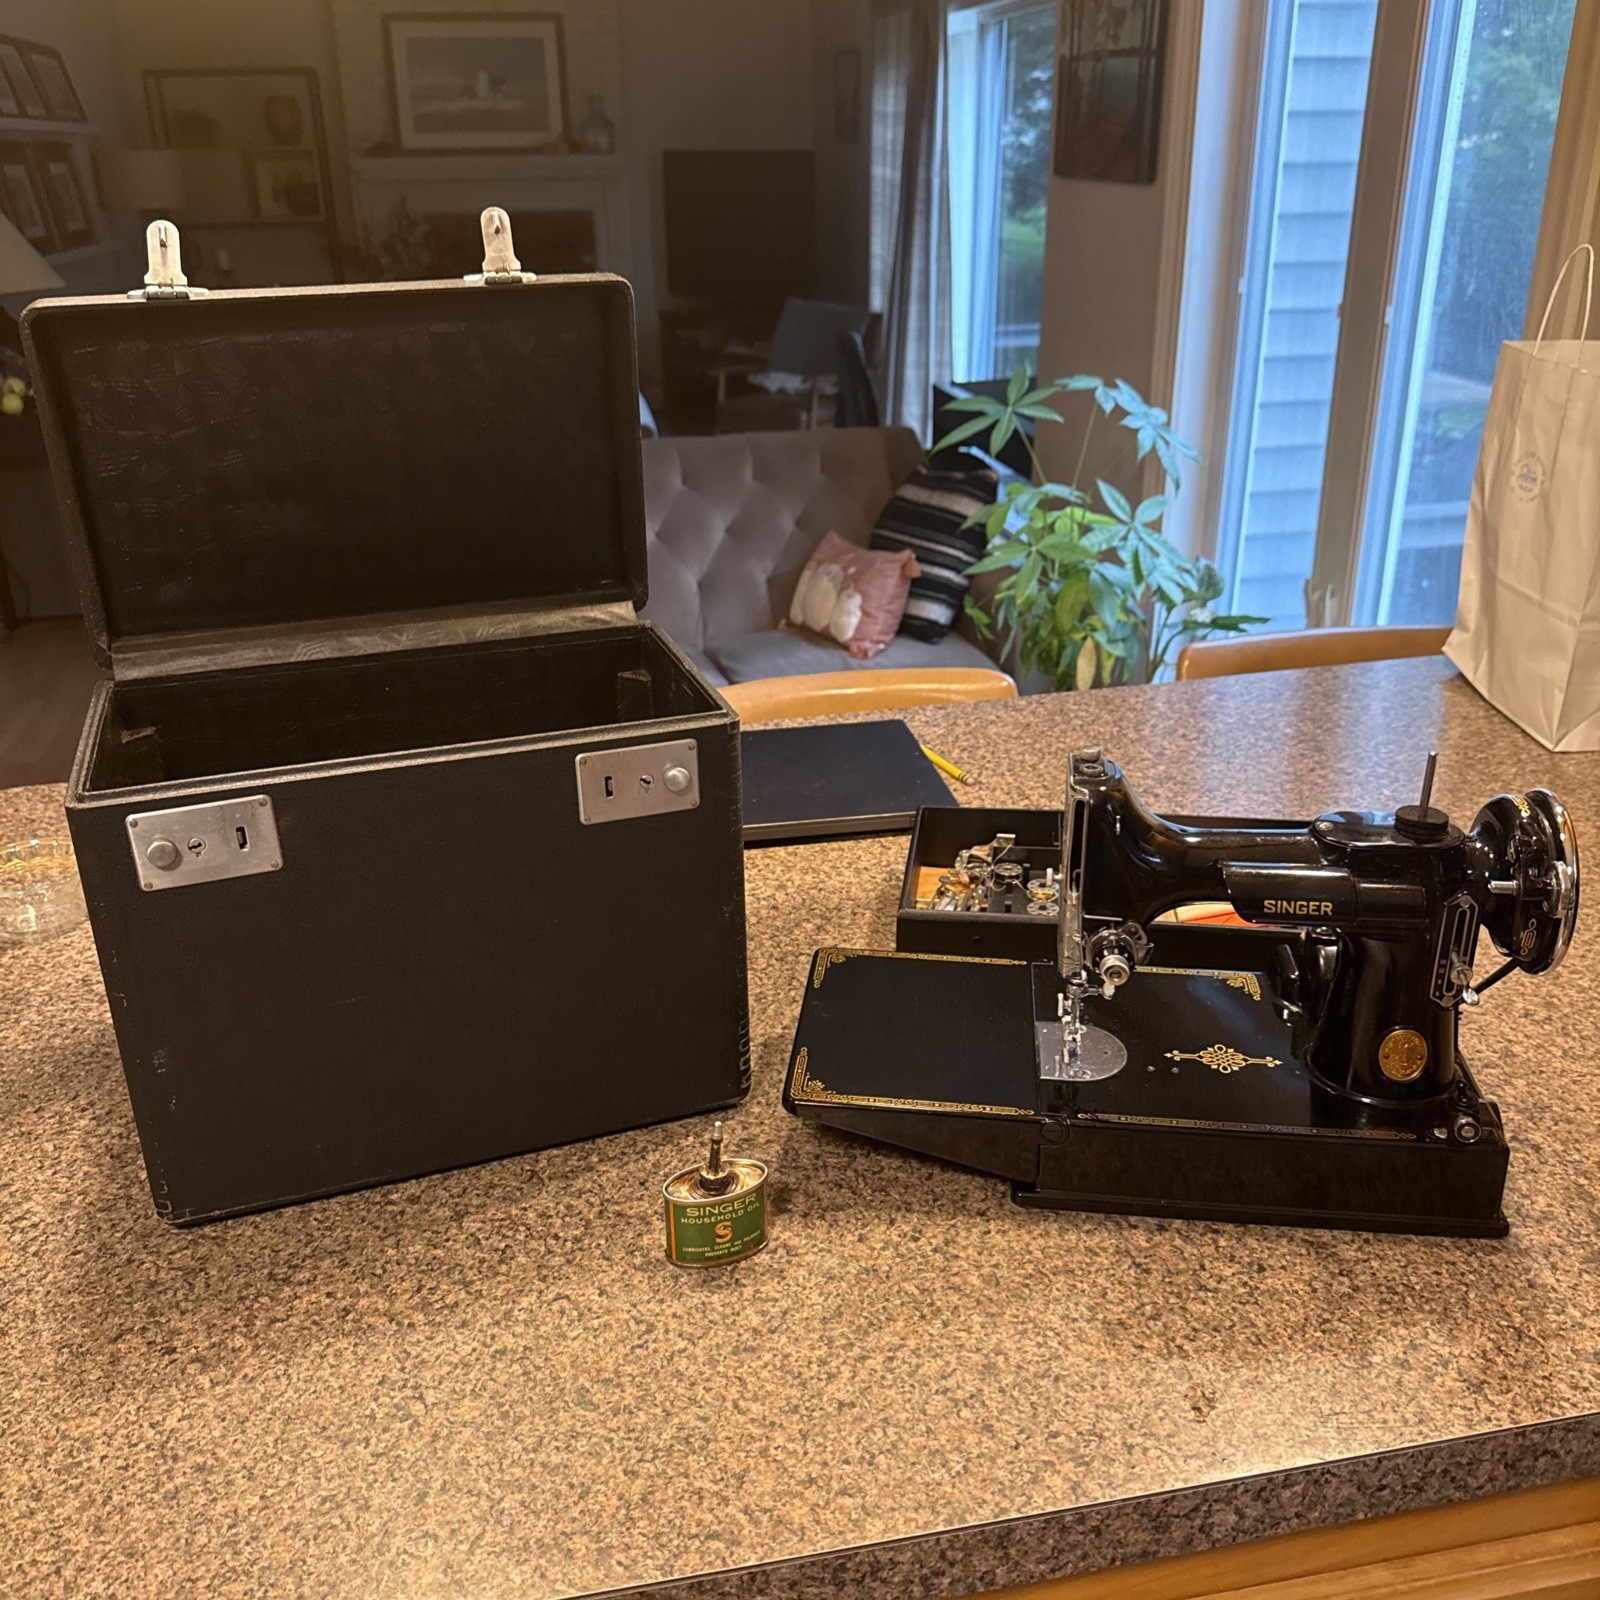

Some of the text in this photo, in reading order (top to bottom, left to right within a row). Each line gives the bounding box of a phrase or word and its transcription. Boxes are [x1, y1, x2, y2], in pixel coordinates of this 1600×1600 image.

[1263, 899, 1333, 915] SINGER
[681, 1202, 760, 1224] HOUSEHOLD OIL
[687, 1193, 756, 1216] SINGER
[715, 1221, 732, 1243] S
